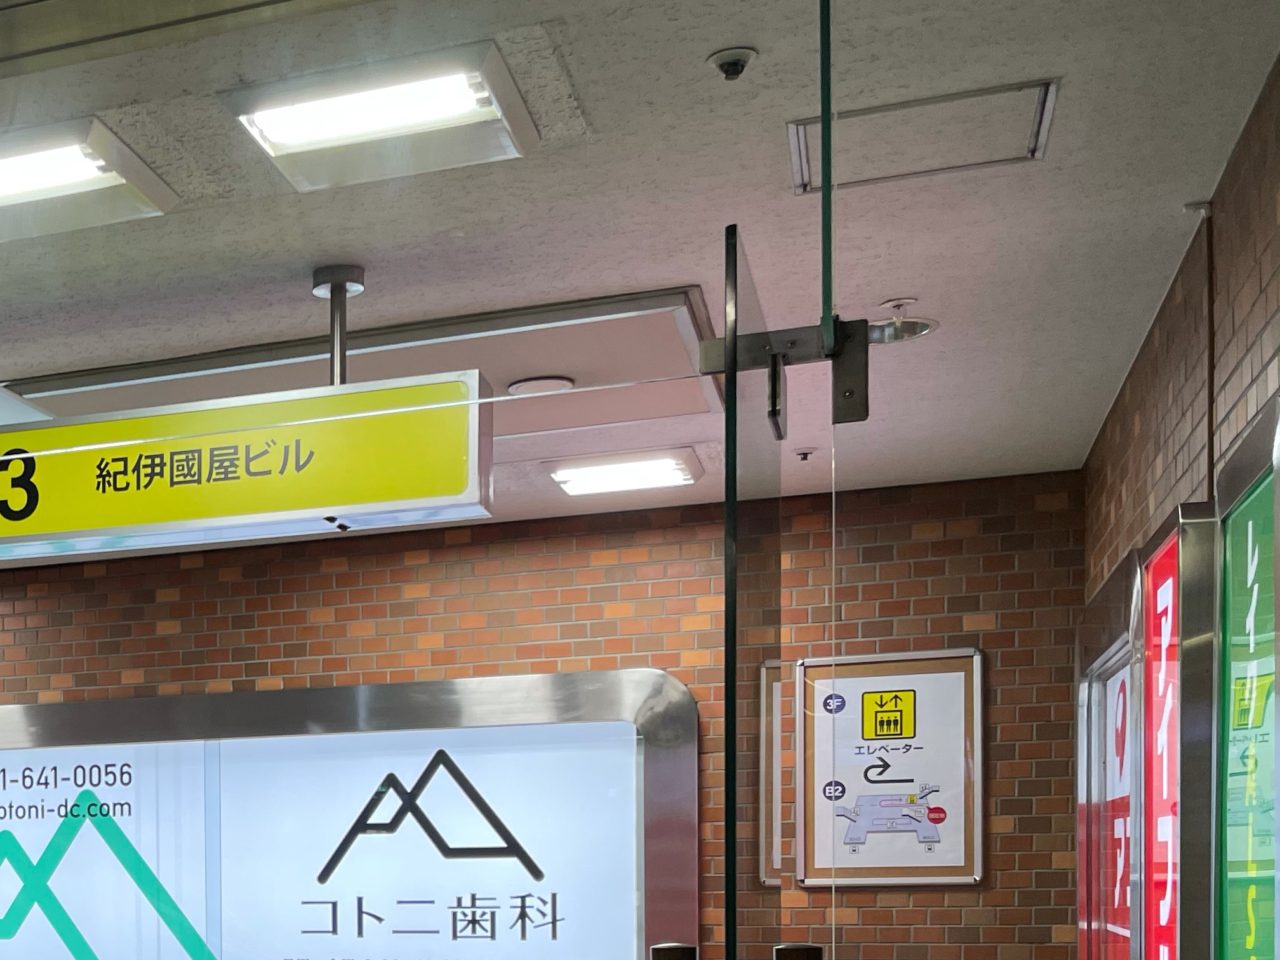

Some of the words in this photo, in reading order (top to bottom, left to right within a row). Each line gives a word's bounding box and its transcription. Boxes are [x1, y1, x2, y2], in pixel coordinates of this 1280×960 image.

[94, 438, 316, 495] 紀伊國屋ビル
[826, 698, 843, 710] 3F
[854, 744, 924, 756] エレベーター
[825, 786, 843, 797] B2
[300, 892, 566, 942] コトニ歯科
